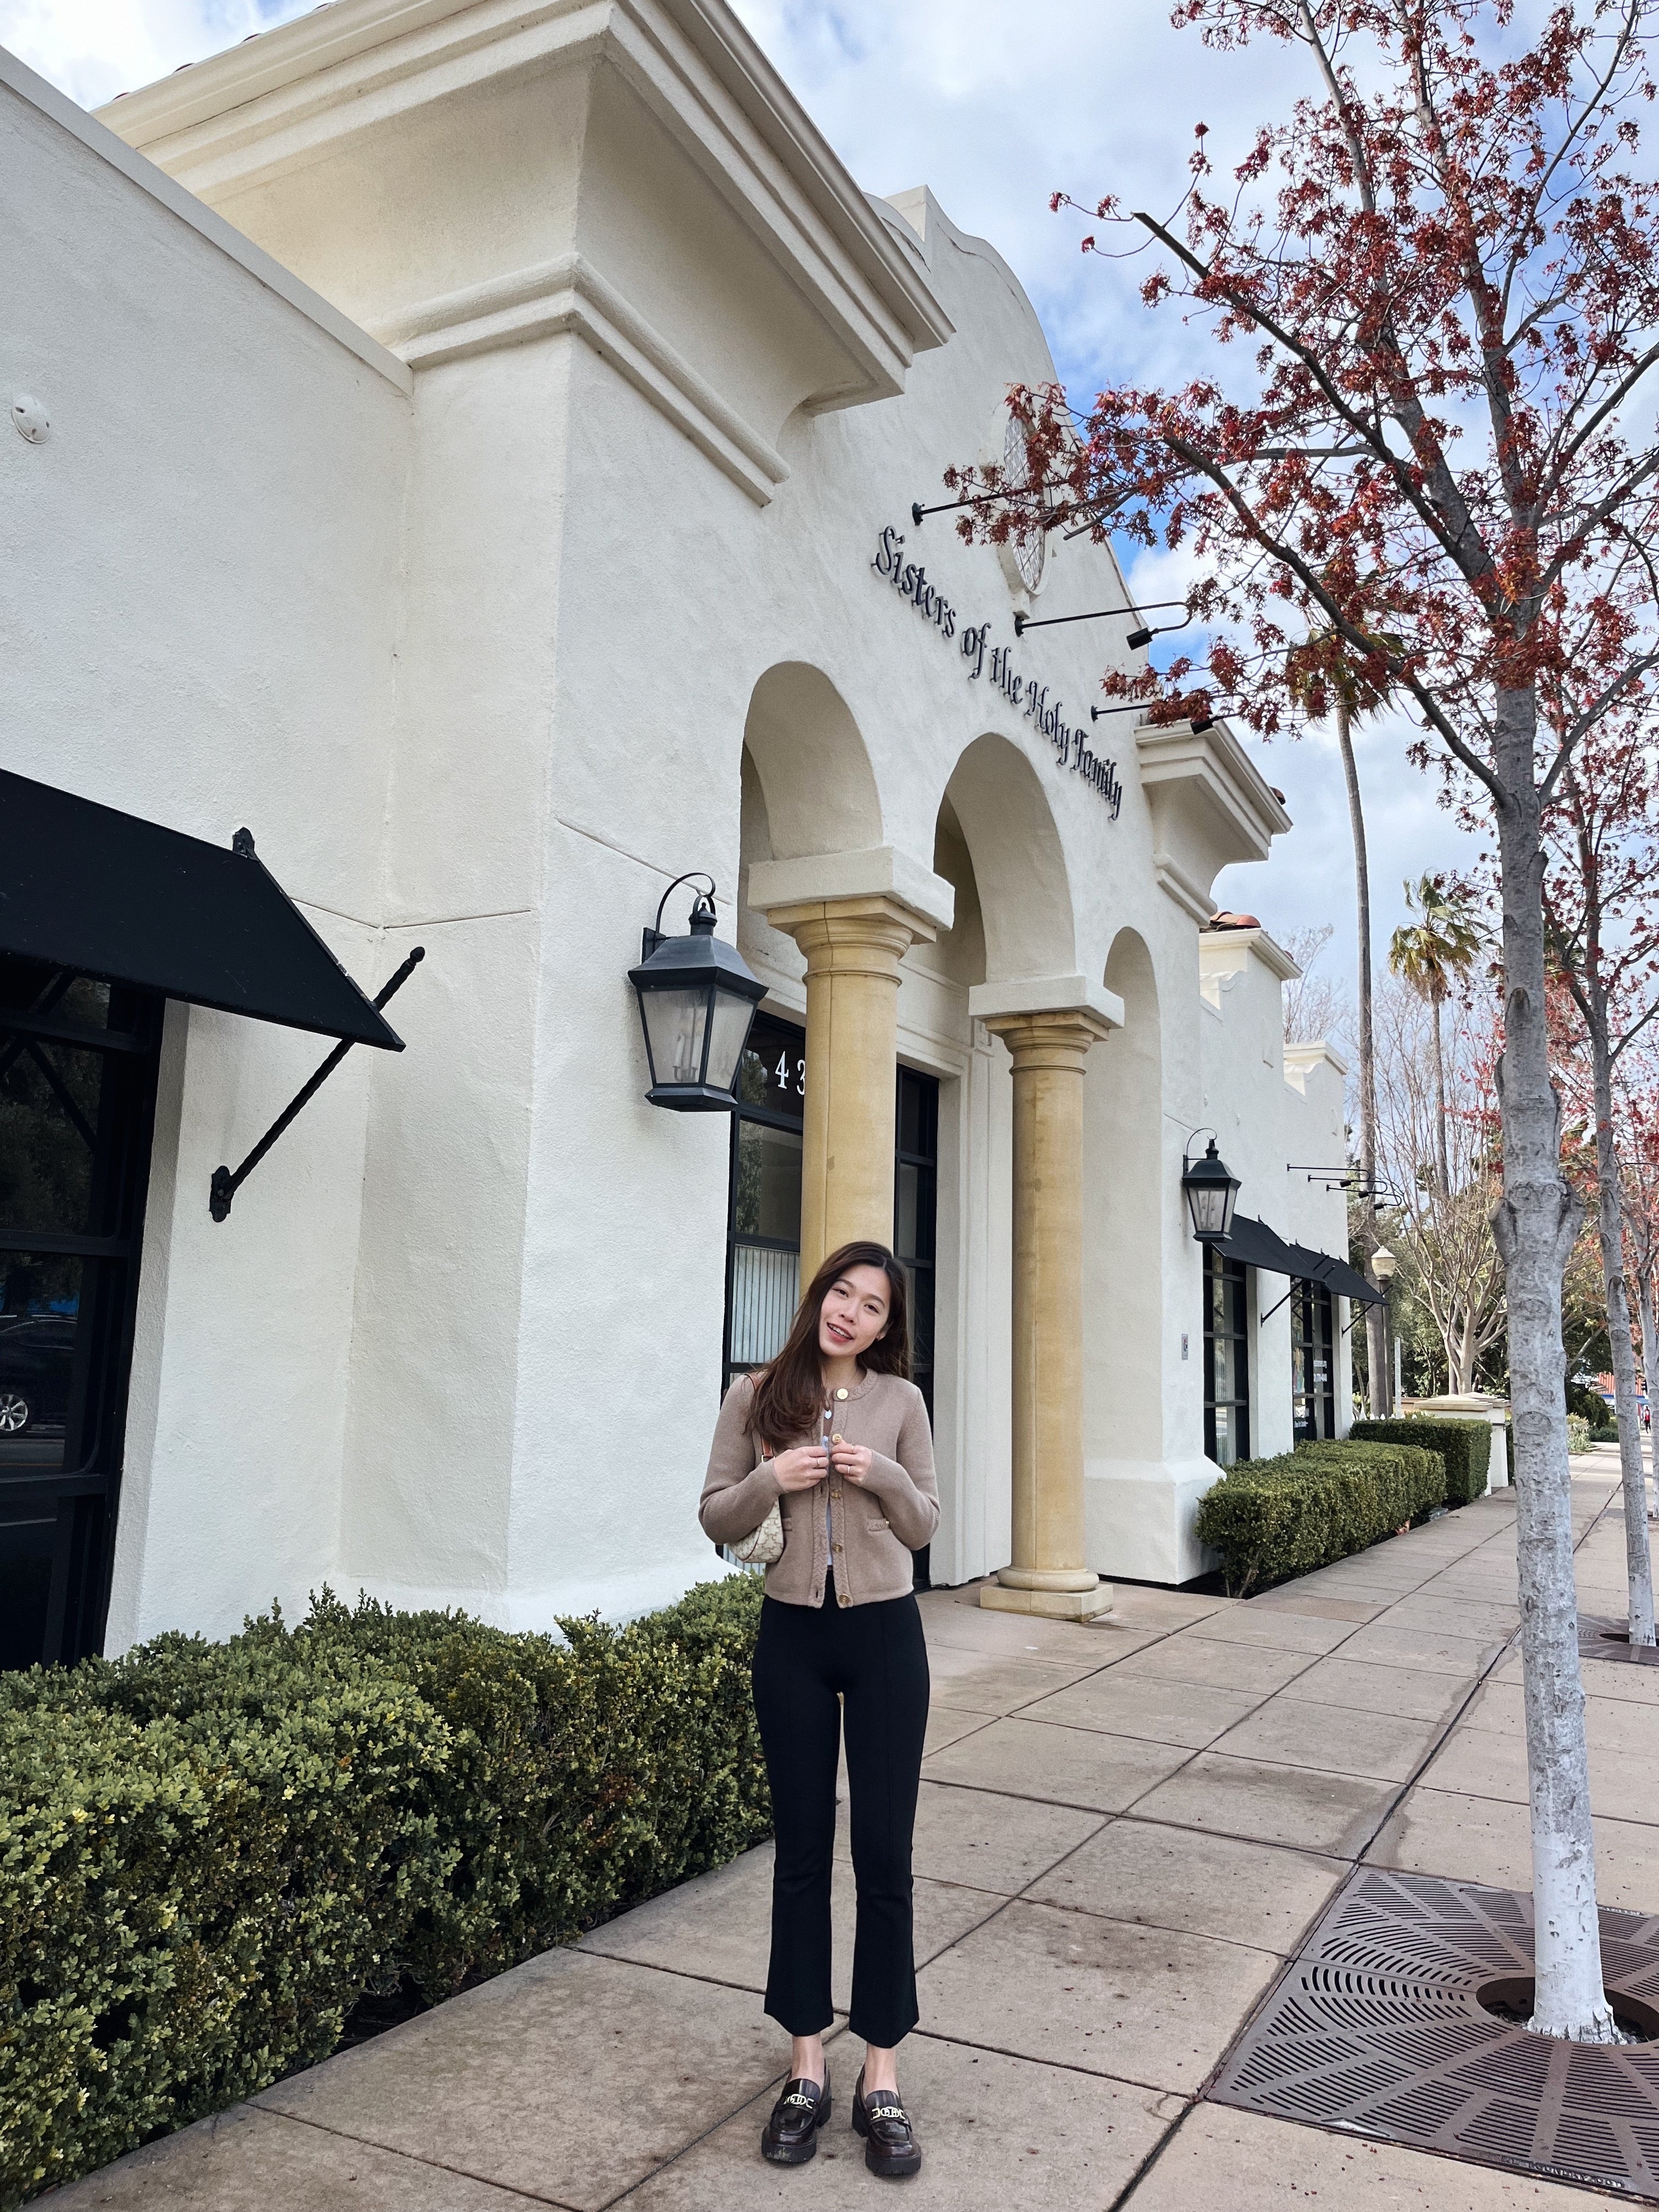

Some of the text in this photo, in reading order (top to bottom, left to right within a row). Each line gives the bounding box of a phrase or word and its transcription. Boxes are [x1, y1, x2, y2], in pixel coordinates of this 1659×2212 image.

[872, 526, 1122, 821] Sisters of the Holy Family
